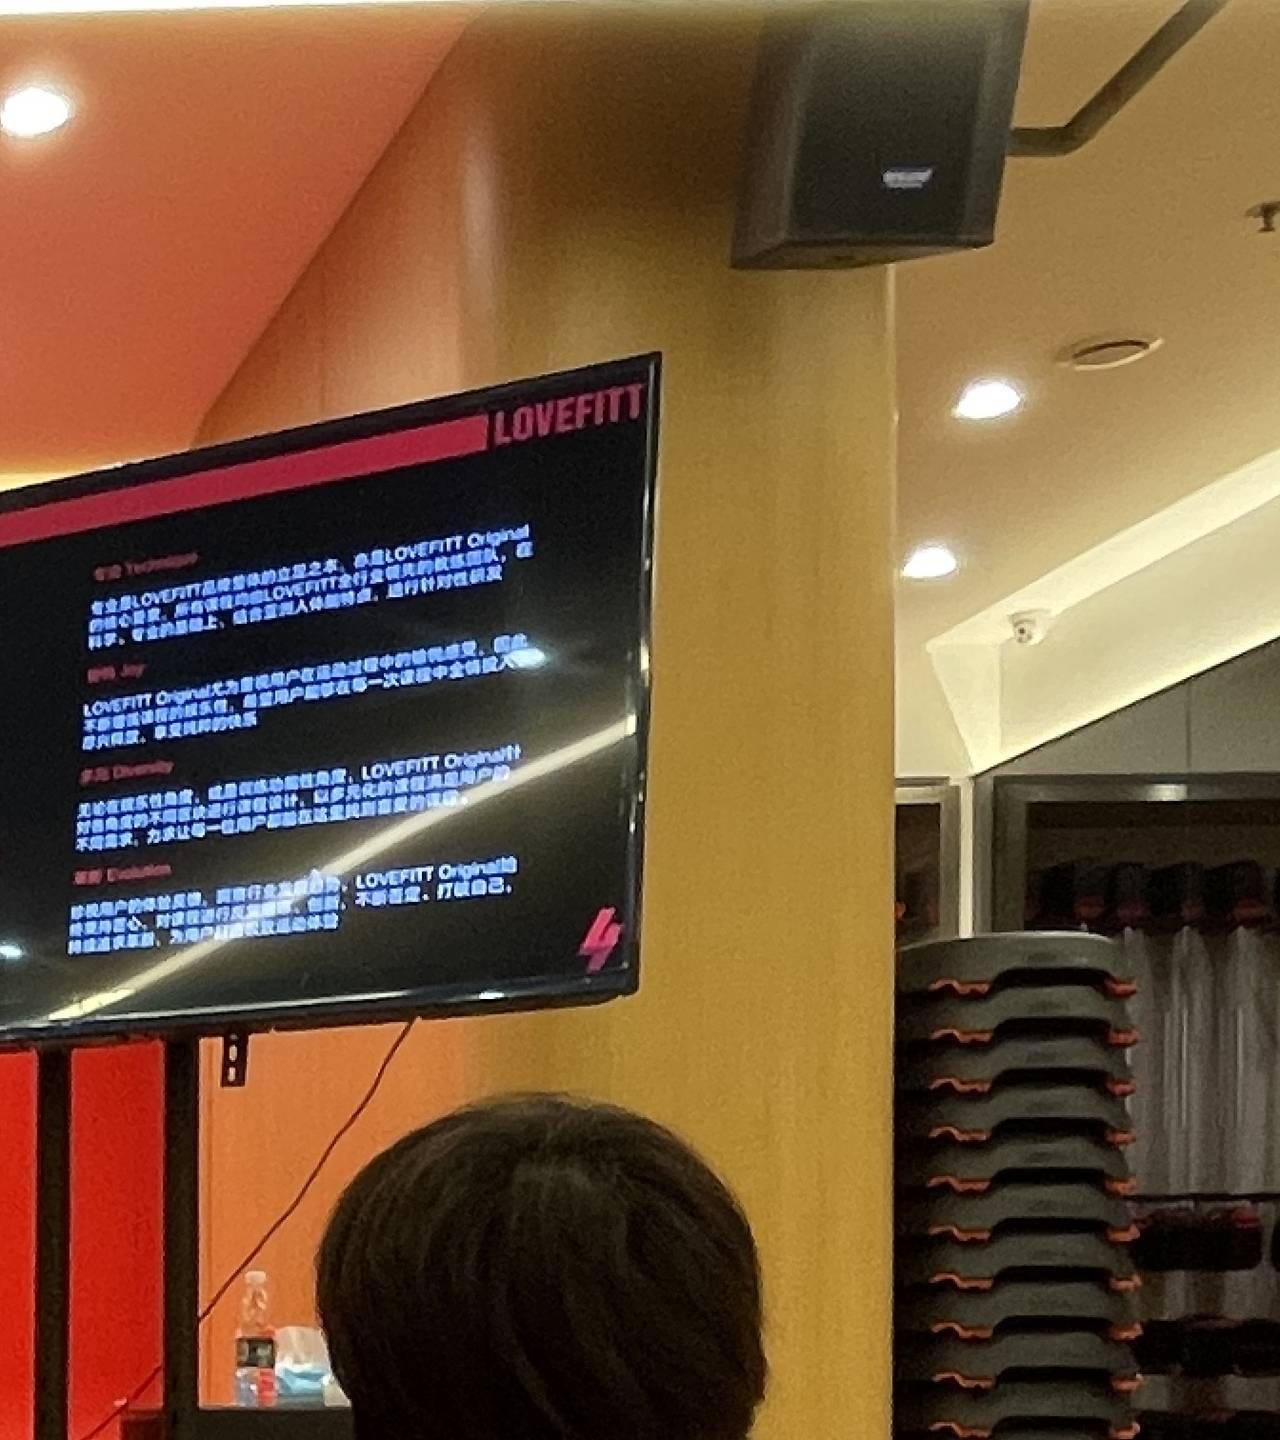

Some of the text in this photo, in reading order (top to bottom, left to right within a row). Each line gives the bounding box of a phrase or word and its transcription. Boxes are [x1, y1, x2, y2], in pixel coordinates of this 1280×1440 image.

[494, 384, 643, 446] LOVEFITT
[361, 755, 440, 780] LOVEFITT
[355, 865, 434, 889] LOVEFITT
